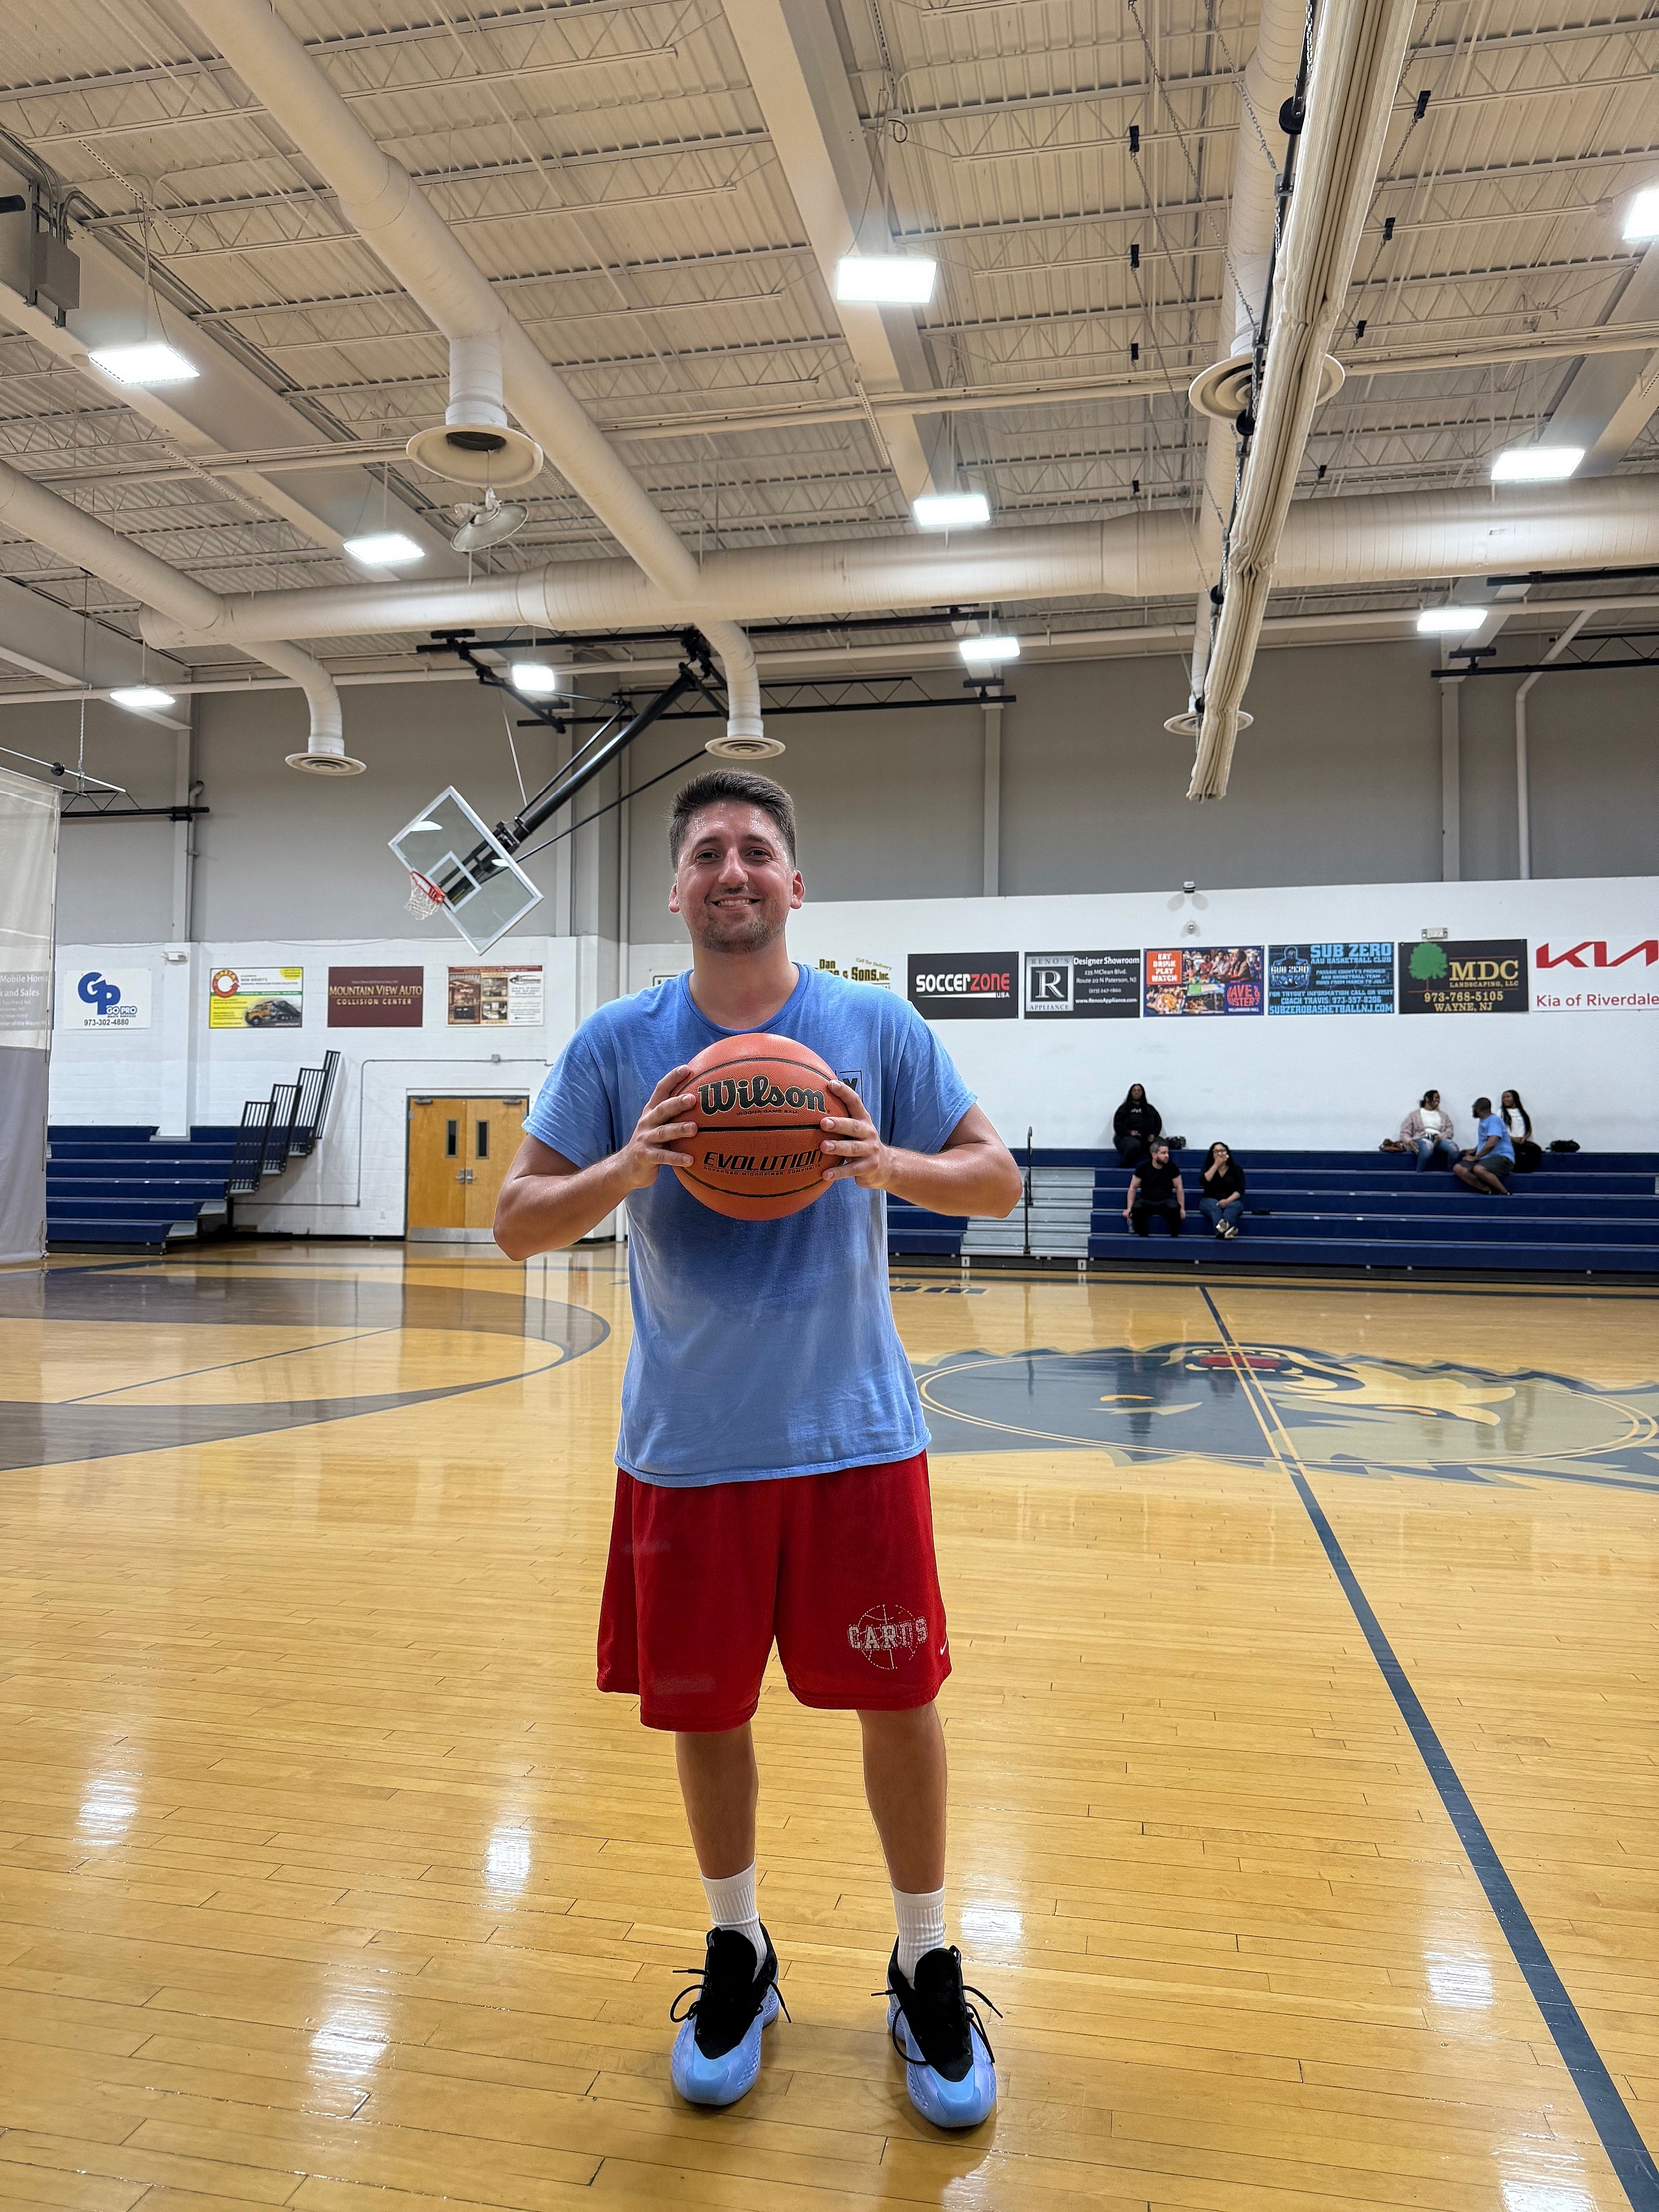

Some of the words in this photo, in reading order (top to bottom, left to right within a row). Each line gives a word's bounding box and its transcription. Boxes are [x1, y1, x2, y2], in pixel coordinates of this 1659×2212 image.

[1310, 944, 1344, 958] SUB
[1348, 943, 1392, 957] ZERO
[1536, 940, 1659, 968] KIA
[819, 959, 836, 969] Dan
[1073, 957, 1103, 967] Designer
[1104, 956, 1139, 964] Showroom
[1449, 960, 1519, 981] MDC
[329, 986, 374, 996] MOUNTAIN
[376, 985, 398, 995] VIEW
[399, 985, 423, 995] AUTO
[1035, 970, 1065, 998] R
[4, 989, 19, 997] and
[21, 988, 40, 997] Sales
[78, 972, 121, 1015] GP
[1424, 990, 1504, 1003] 973-768-5105
[1537, 994, 1561, 1007] Kia
[1566, 994, 1582, 1006] of
[1587, 993, 1659, 1006] Riverdale
[106, 1006, 120, 1015] GO
[120, 1006, 138, 1015] PRO
[1269, 1004, 1393, 1014] SUBZEROBASKETBALLNJ.COM
[1434, 1002, 1477, 1012] WAYNE,
[1479, 1002, 1493, 1011] NJ
[697, 1075, 827, 1116] Wilson
[703, 1148, 823, 1171] EVOLUTION
